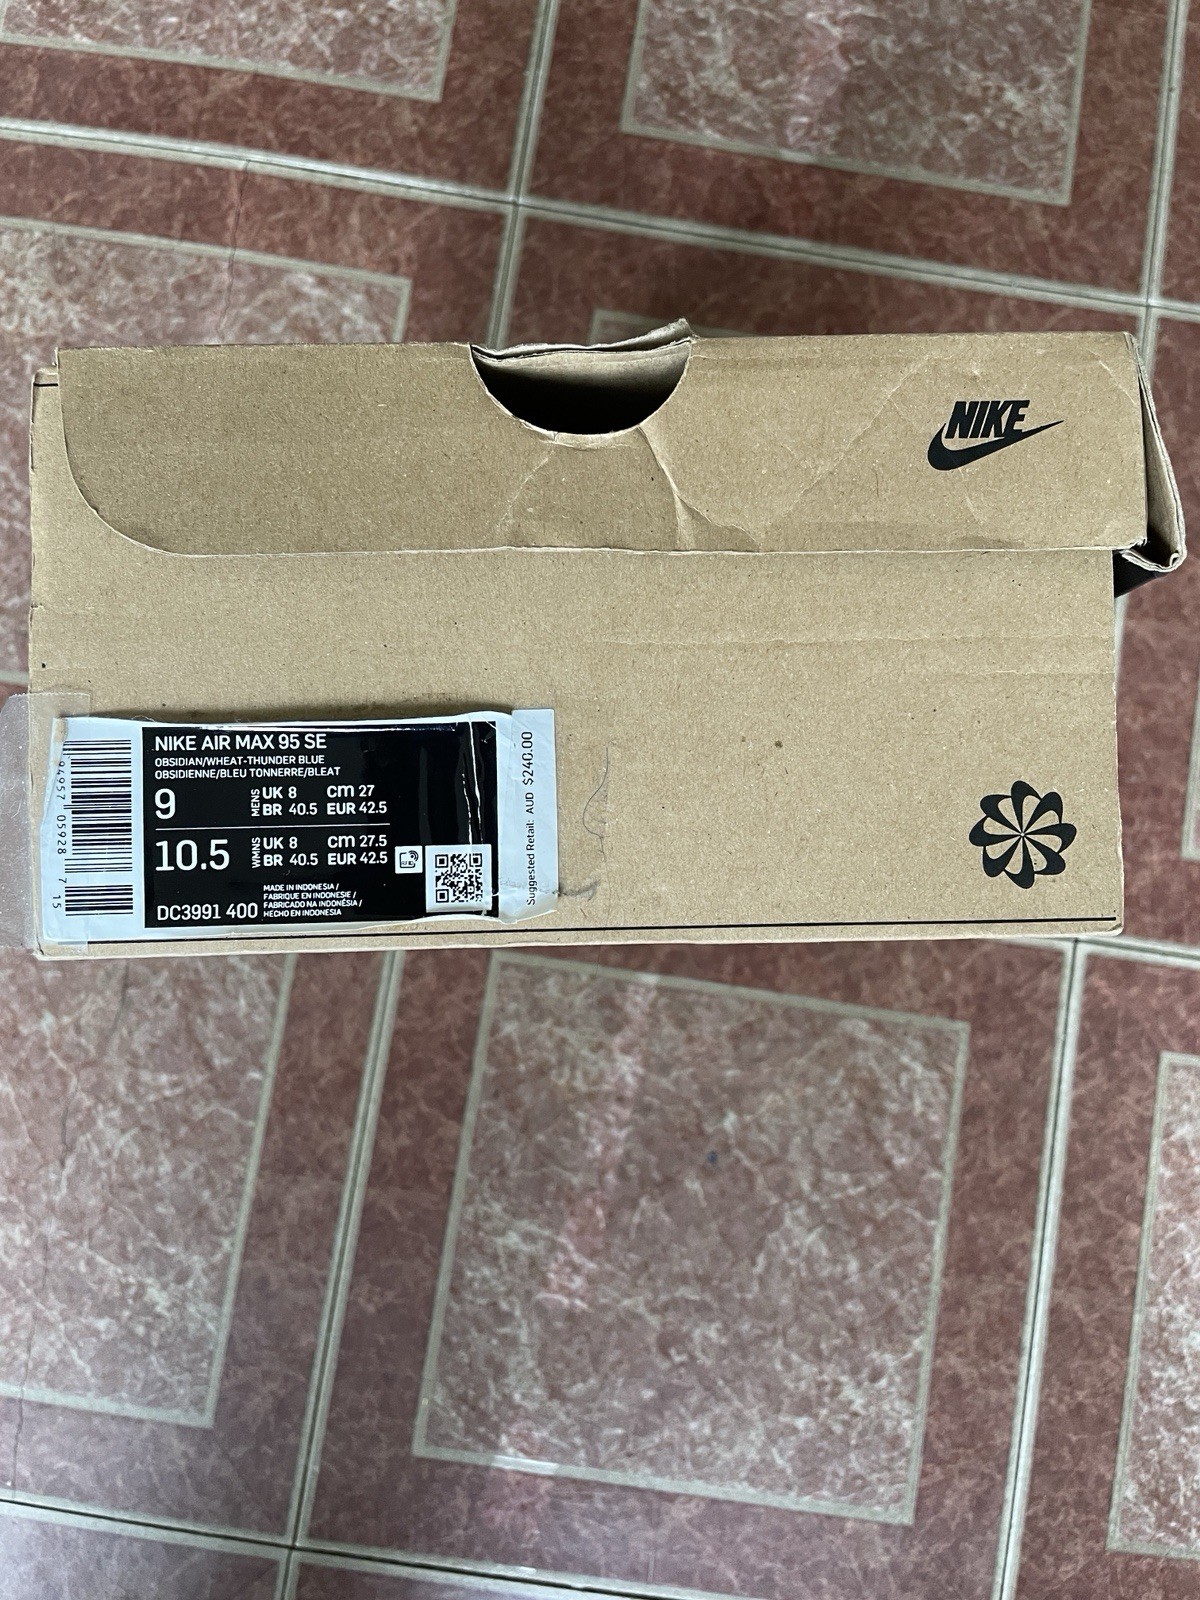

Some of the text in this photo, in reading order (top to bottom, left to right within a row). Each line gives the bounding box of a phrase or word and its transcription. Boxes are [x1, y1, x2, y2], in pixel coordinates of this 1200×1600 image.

[945, 400, 1030, 438] NIKE
[155, 733, 327, 751] NIKE AIR MAX 95 SE
[154, 755, 325, 767] OBSIDIAN/WHEAT-THUNDER BLUE
[154, 767, 341, 779] OBSIDIENNE/BLEU TONNERRE/BLEAT
[262, 787, 283, 799] UK
[288, 786, 297, 799] 8
[358, 785, 375, 797] 27
[154, 788, 176, 820] 9
[250, 788, 260, 817] MENS
[262, 801, 388, 816] BR 40.5 EUR 42.5
[521, 731, 538, 906] Suggested Retail: AUD $240.00
[57, 814, 67, 855] 05928
[263, 837, 284, 849] UK
[289, 837, 298, 849] 8
[359, 834, 388, 847] 27.5
[155, 839, 230, 871] 10.5
[251, 837, 261, 869] WMNS
[263, 851, 389, 866] BR 40.5 EUR 42.5
[263, 884, 285, 892] MADE
[286, 883, 294, 891] IN
[295, 883, 334, 891] INDONESIA
[53, 895, 62, 909] 15
[263, 892, 300, 901] FABRIQUE
[263, 901, 305, 909] FABRICADO
[306, 900, 318, 908] NA
[318, 898, 358, 907] INDONÉSIA
[157, 902, 258, 920] DC3991 400
[263, 908, 342, 918] HECHO EN INDONESIA
